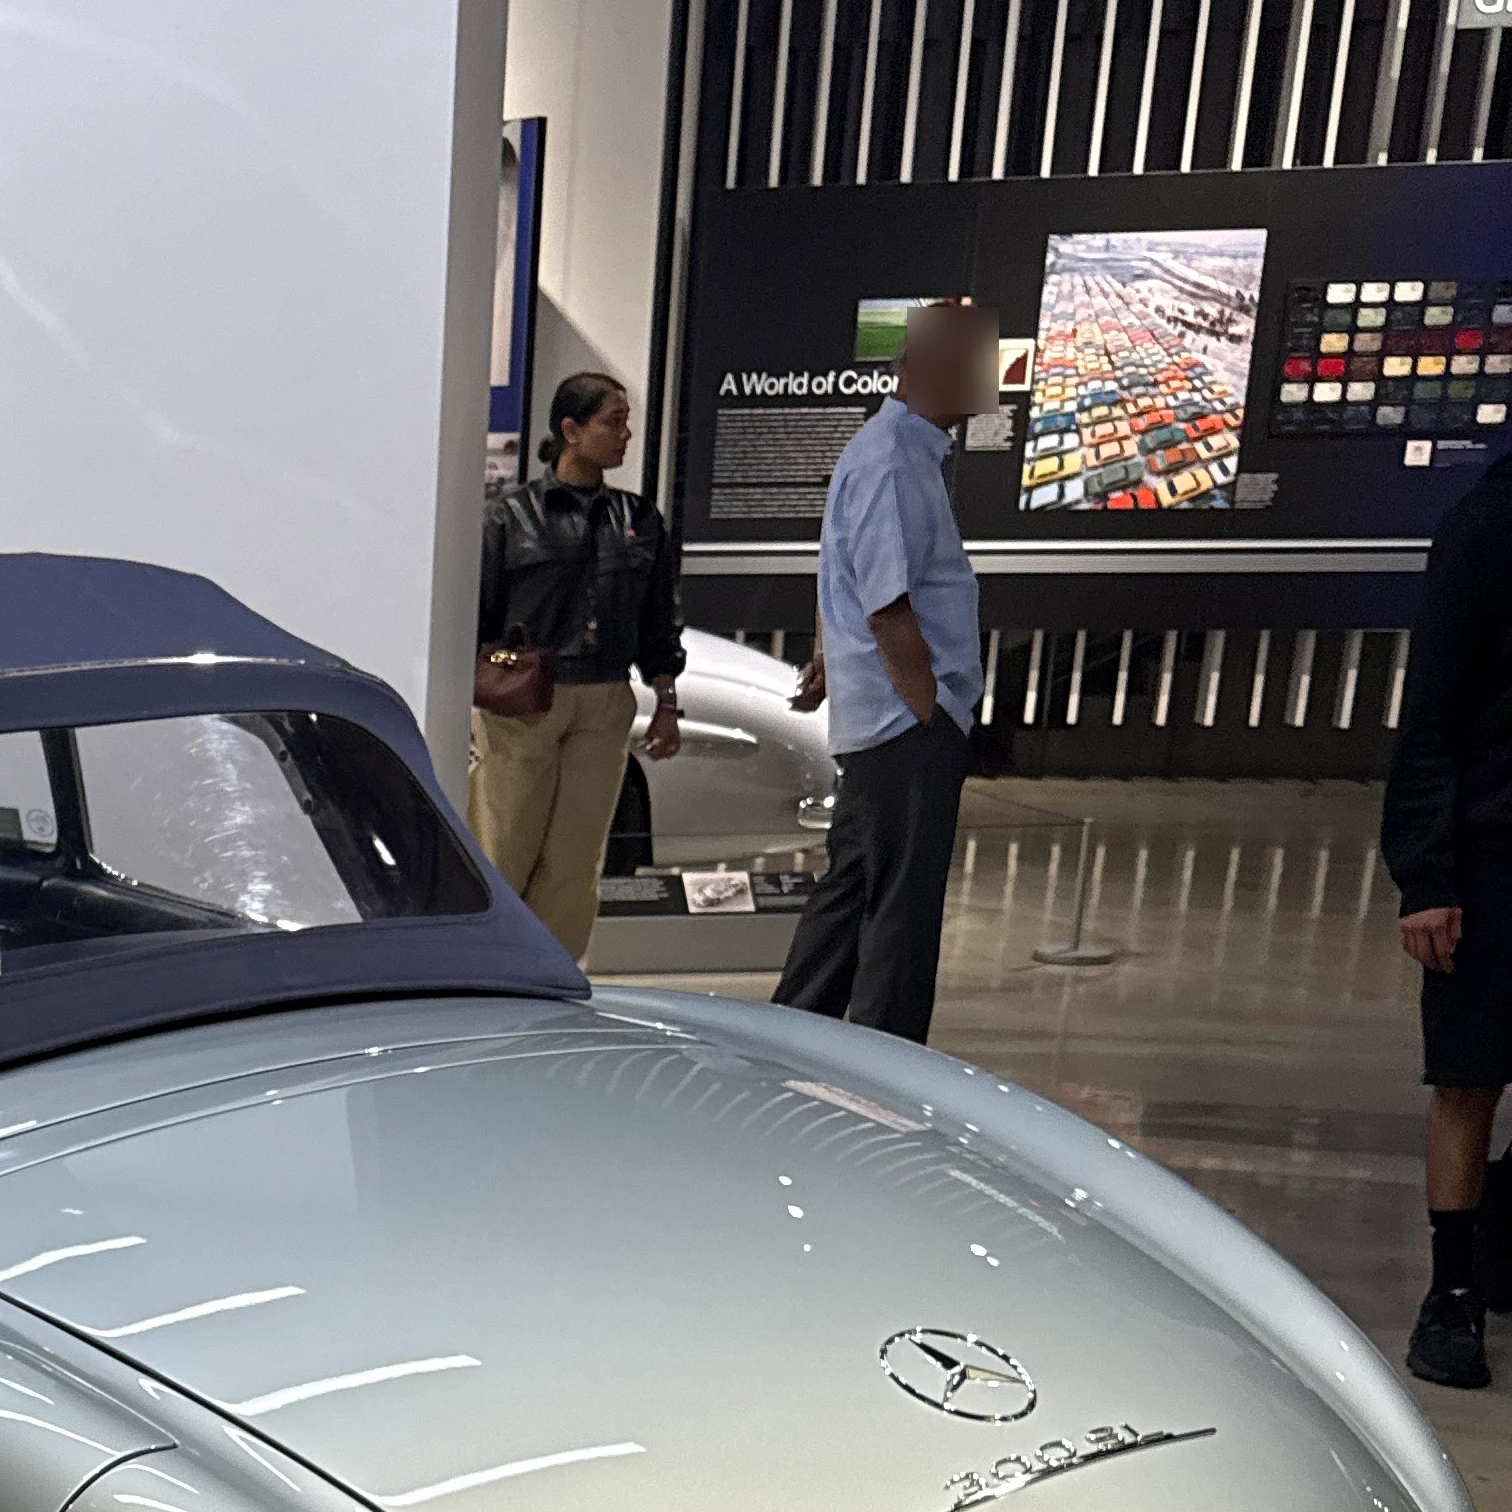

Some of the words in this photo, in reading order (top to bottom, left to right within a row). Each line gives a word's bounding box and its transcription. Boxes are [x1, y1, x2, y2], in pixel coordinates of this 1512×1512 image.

[719, 372, 738, 396] A
[742, 370, 808, 396] World
[811, 370, 836, 395] of
[944, 1438, 1076, 1509] 300
